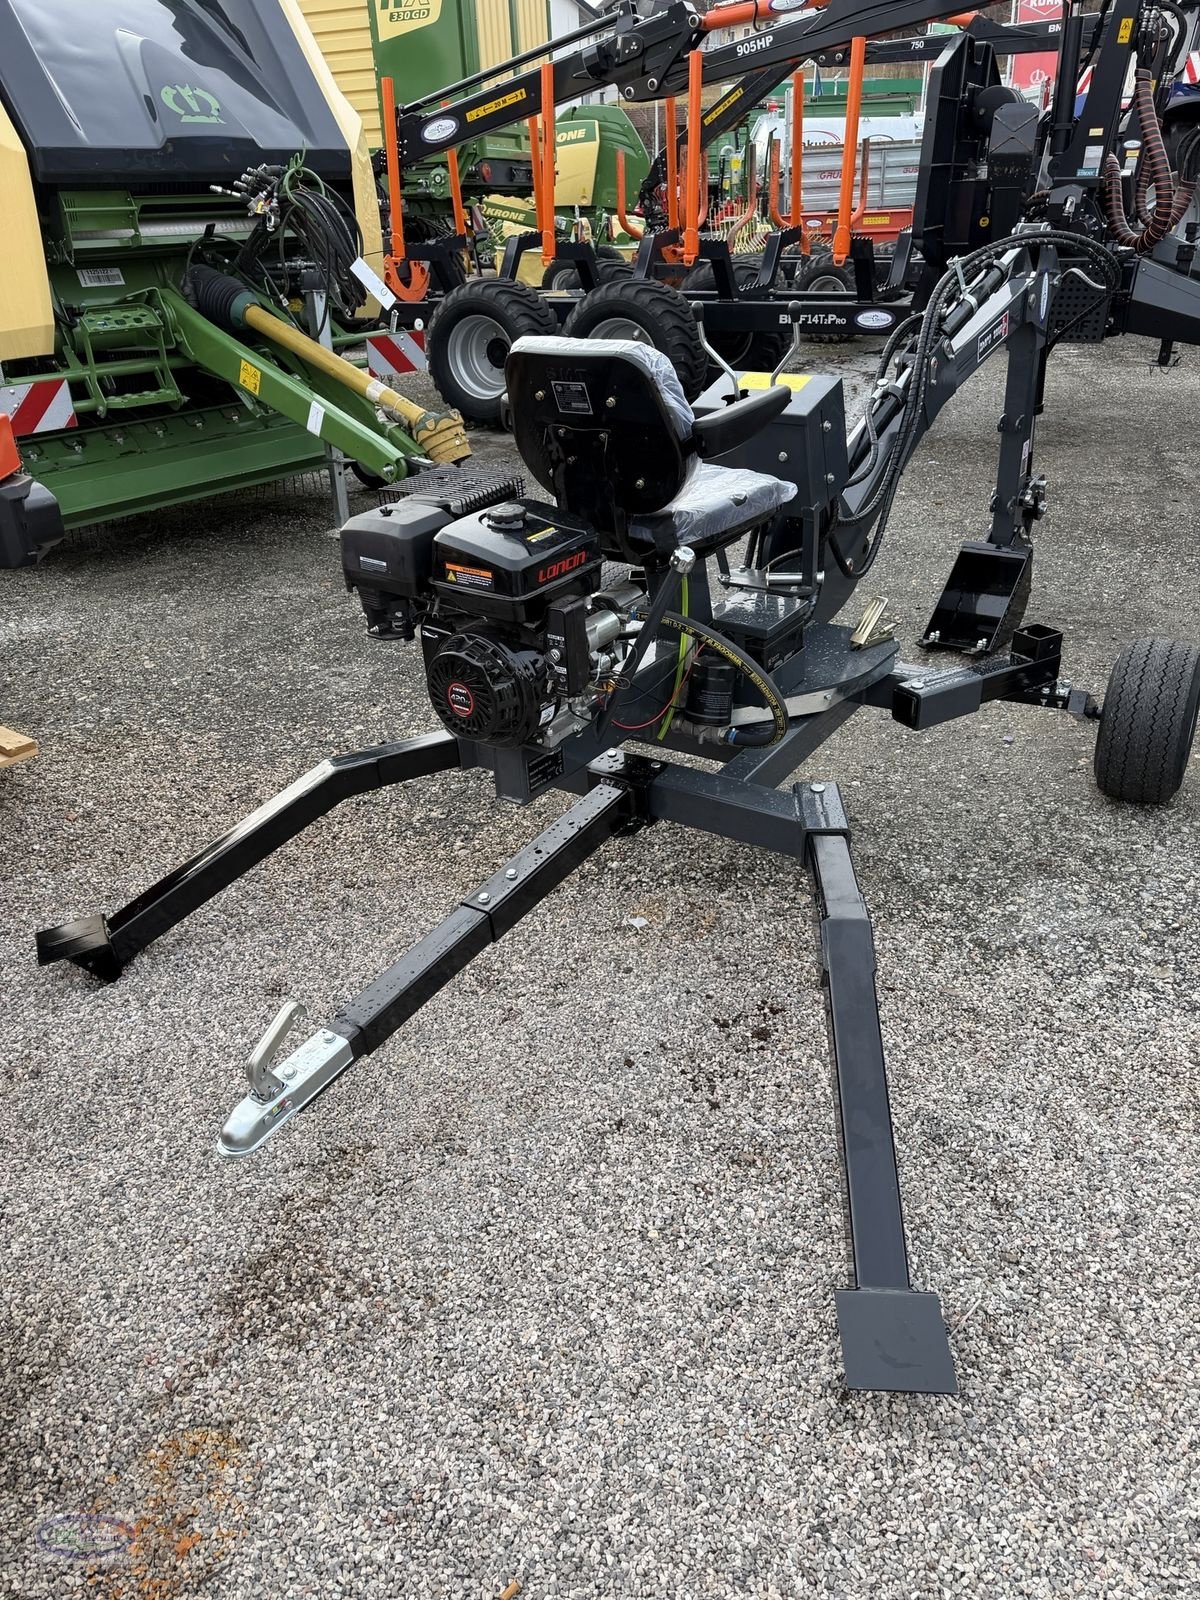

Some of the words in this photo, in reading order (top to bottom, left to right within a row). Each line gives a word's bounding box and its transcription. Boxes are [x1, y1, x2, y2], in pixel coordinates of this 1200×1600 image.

[736, 35, 774, 57] 905HP
[910, 40, 925, 50] 750
[555, 128, 587, 143] ONE
[486, 207, 526, 221] KRONE
